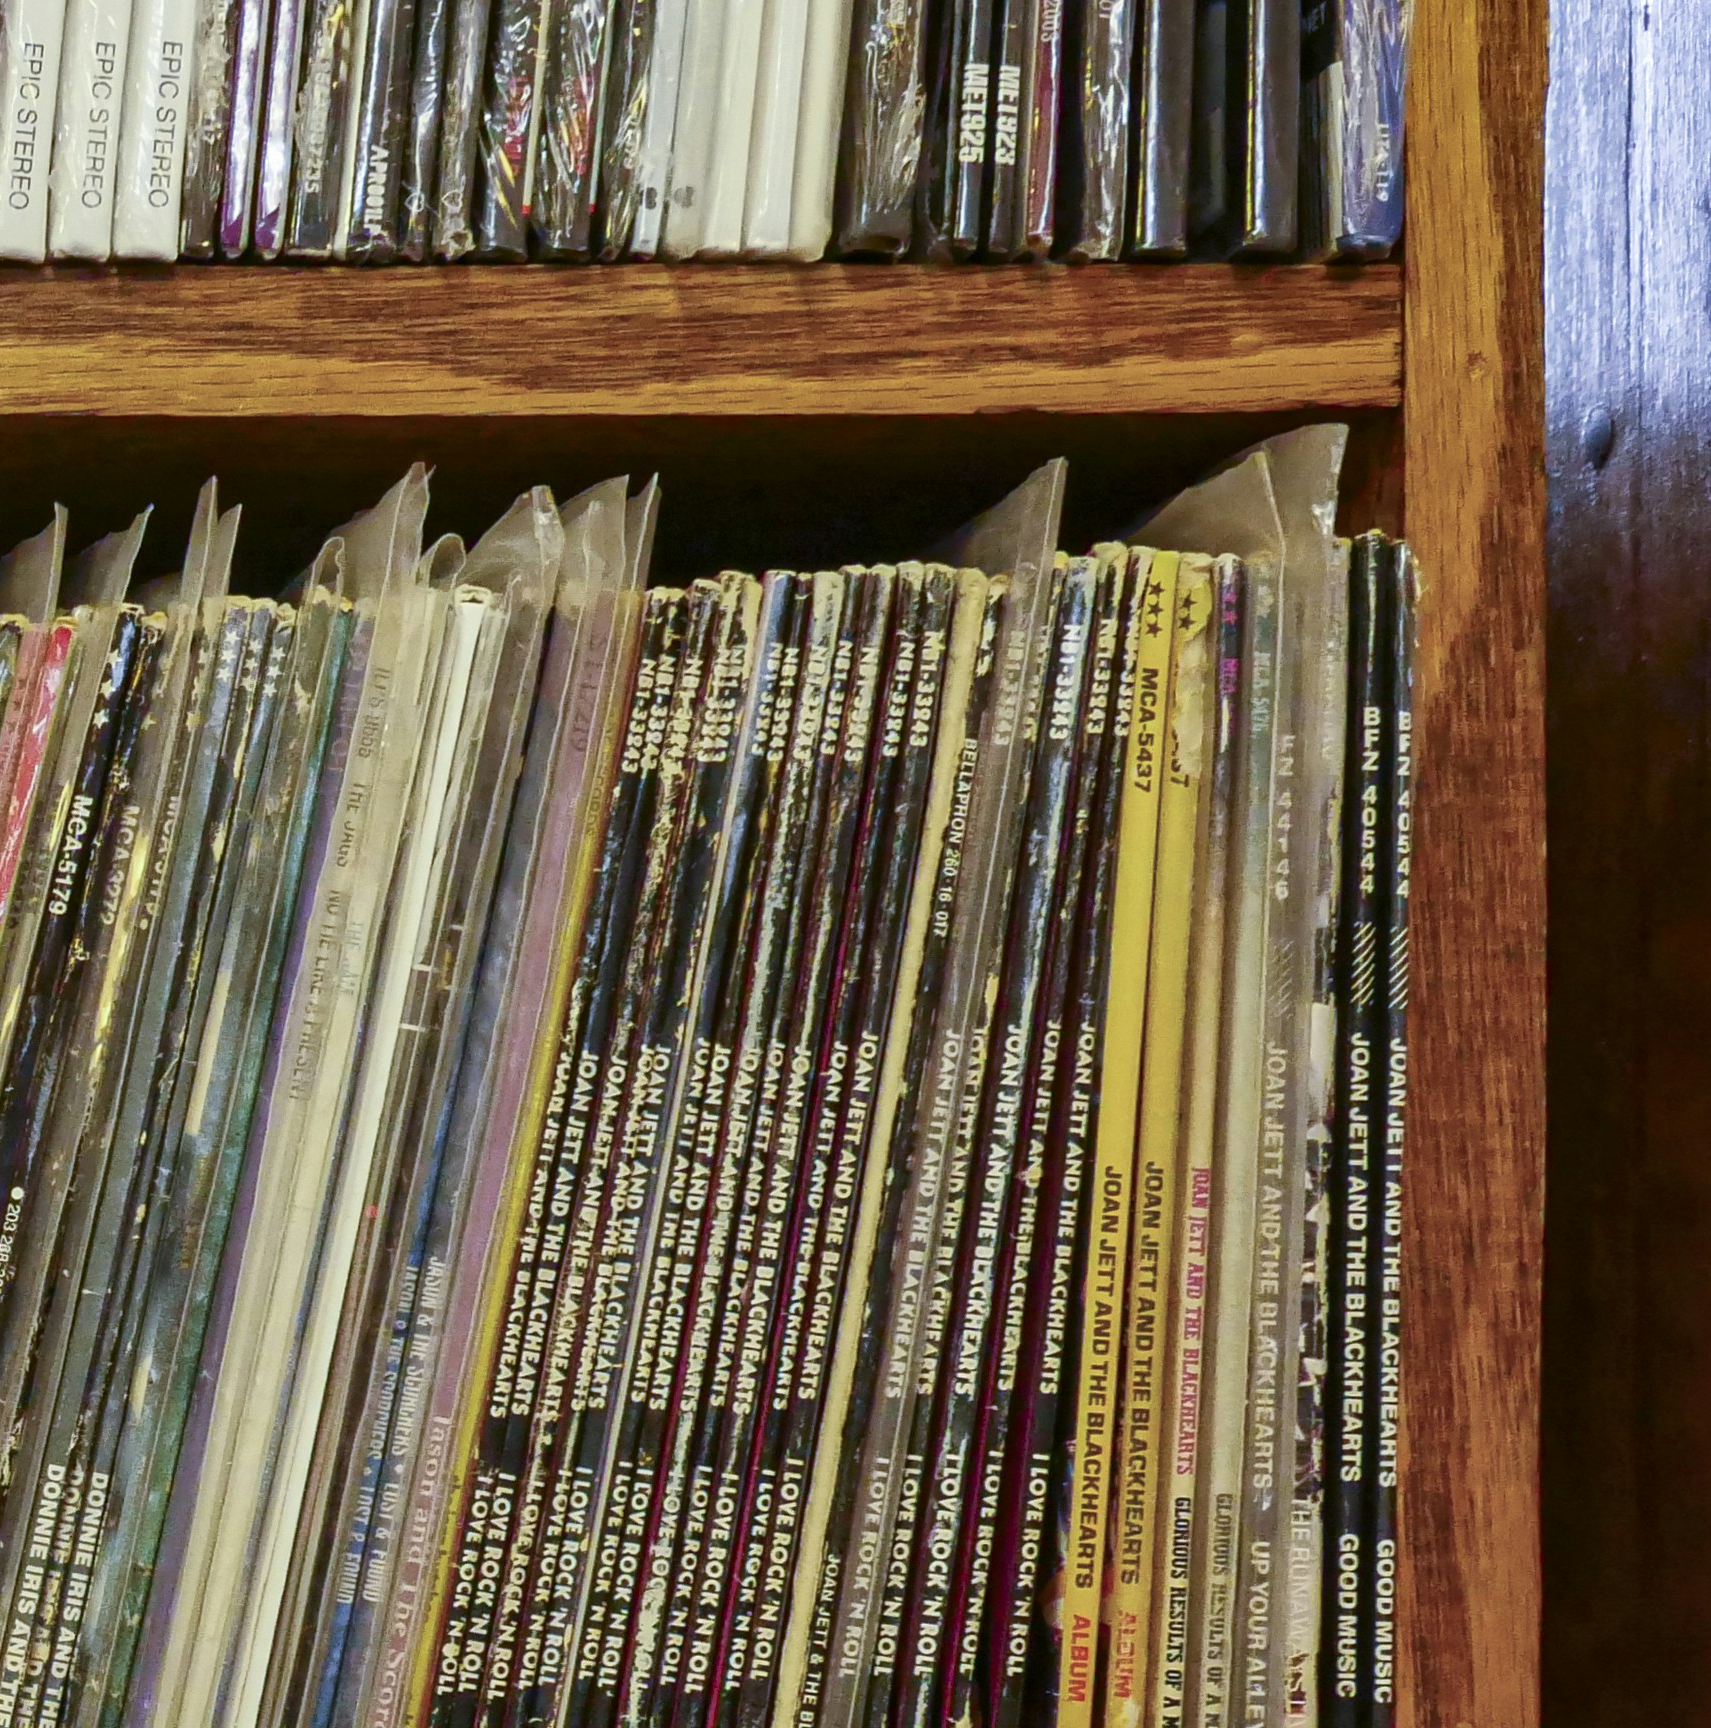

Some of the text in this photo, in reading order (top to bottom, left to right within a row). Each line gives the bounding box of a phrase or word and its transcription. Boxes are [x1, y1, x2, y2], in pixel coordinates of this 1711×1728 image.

[7, 42, 46, 211] EPIC STEREO
[146, 40, 184, 209] EPIC STEREO
[958, 62, 988, 163] MET925
[1132, 666, 1159, 792] MCA-5437
[47, 793, 91, 917] MCA-5179
[1360, 707, 1379, 894] BFZ 40544
[1340, 1032, 1370, 1482] JOAN JETT AND THE BLACKHEARTS
[1074, 1165, 1121, 1589] JOAN JETT AND THE BLACKHEARTS
[1023, 1466, 1048, 1522] LOVE
[1015, 1527, 1040, 1589] ROCK
[1246, 1581, 1268, 1649] YOUR
[1247, 1541, 1268, 1574] UP
[1336, 1533, 1359, 1698] GOOD MUSIC
[1004, 1623, 1028, 1677] ROLL
[1065, 1614, 1091, 1702] ALBUM
